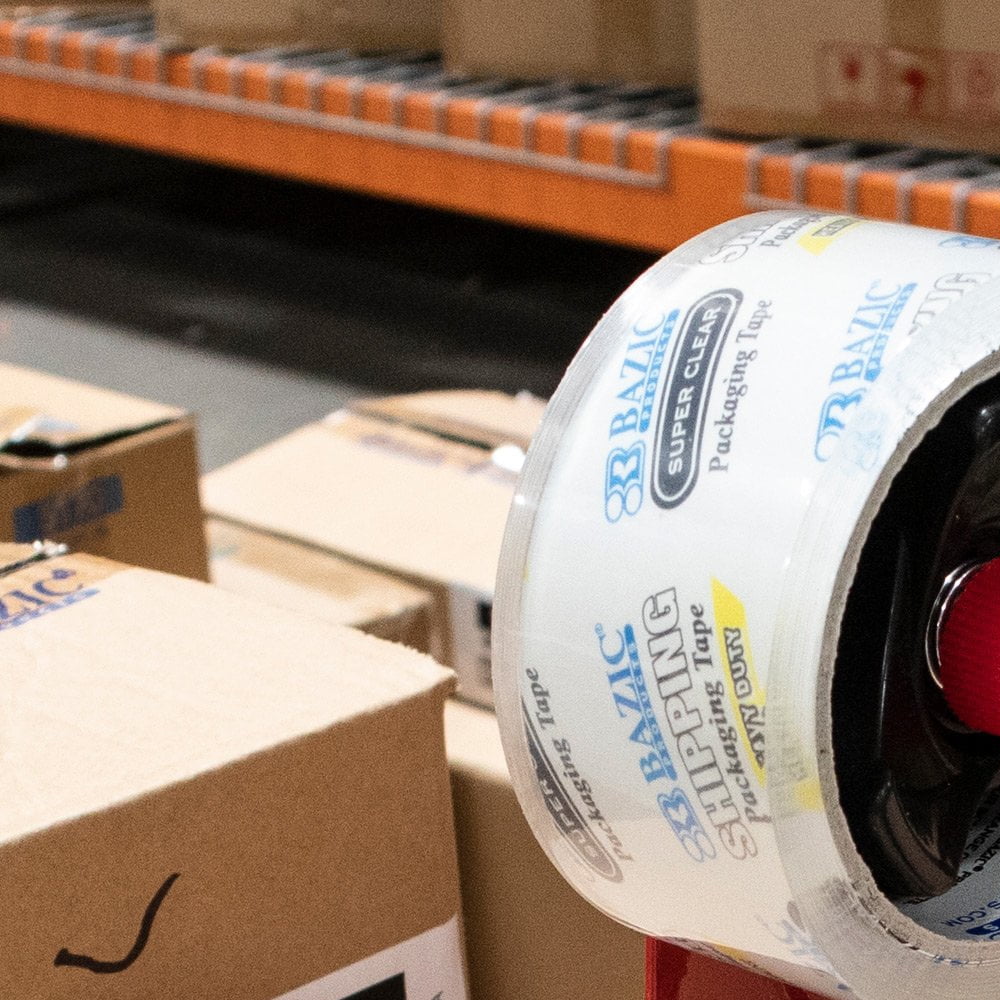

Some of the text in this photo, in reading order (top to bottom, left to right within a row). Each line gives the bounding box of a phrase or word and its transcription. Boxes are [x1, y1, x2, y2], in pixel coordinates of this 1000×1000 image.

[609, 310, 666, 439] BAZIC
[668, 305, 722, 476] SUPER CLEAR
[709, 341, 758, 473] Packaging
[736, 299, 773, 345] Tape
[526, 667, 554, 729] Tape
[642, 587, 757, 860] SHIPPING
[690, 603, 771, 824] Packaging Tape
[723, 626, 752, 700] DUTY
